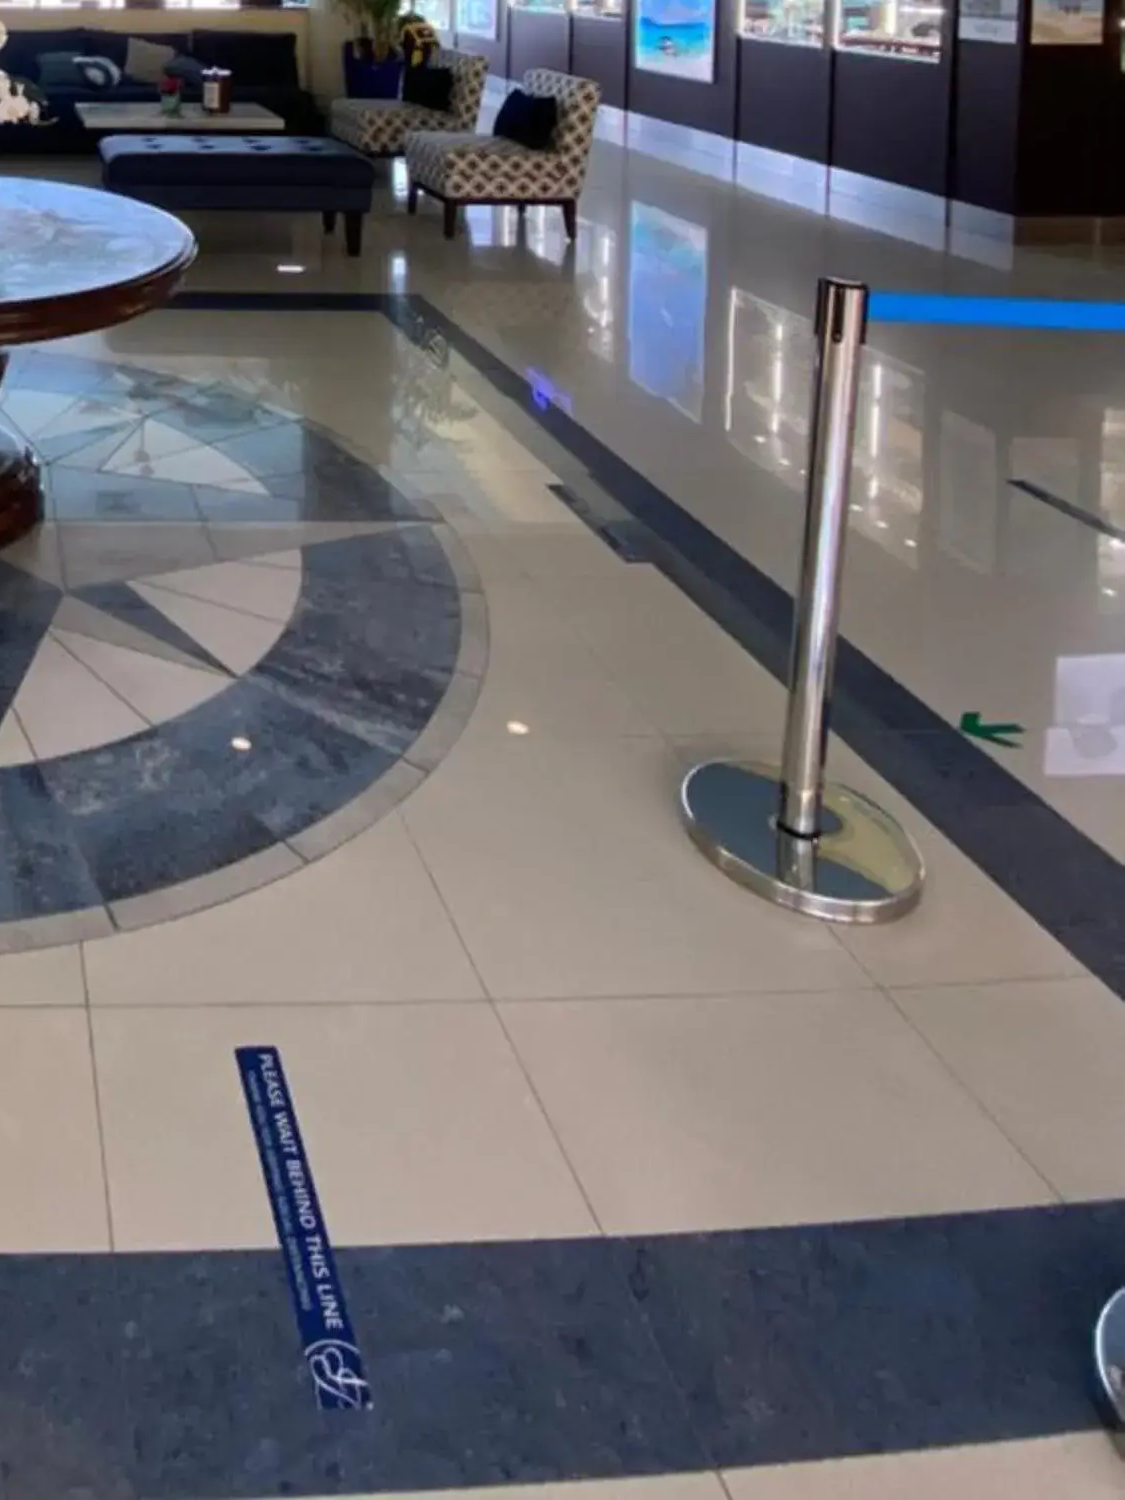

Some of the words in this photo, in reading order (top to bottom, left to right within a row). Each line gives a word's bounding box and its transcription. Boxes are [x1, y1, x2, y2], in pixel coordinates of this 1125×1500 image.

[258, 1053, 286, 1108] PLEASE
[273, 1111, 299, 1154] WAIT
[285, 1159, 316, 1229] BEHIND
[305, 1235, 330, 1279] THIS
[316, 1283, 343, 1330] LINE
